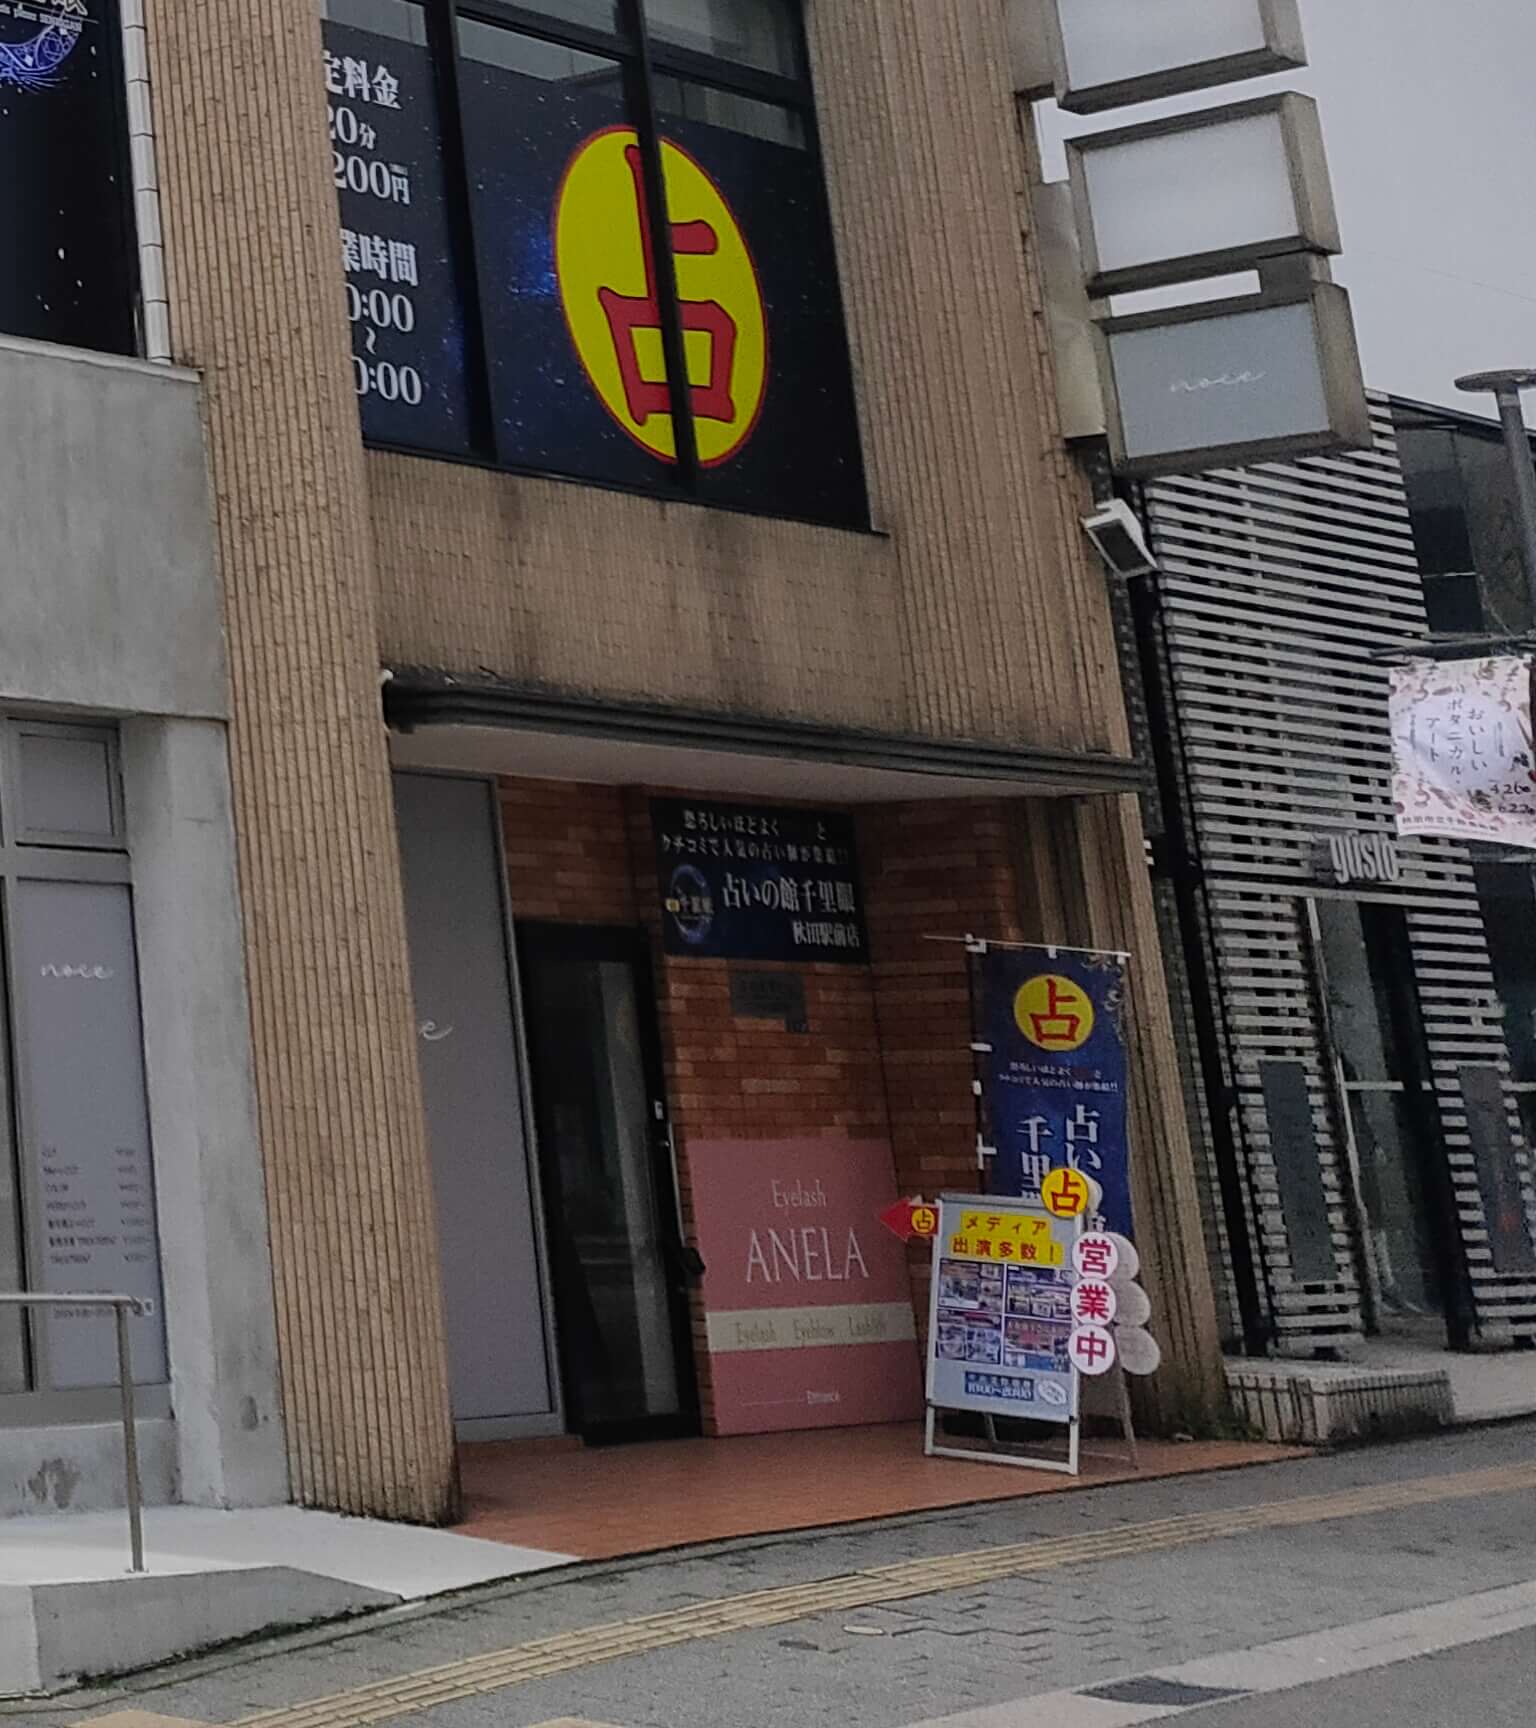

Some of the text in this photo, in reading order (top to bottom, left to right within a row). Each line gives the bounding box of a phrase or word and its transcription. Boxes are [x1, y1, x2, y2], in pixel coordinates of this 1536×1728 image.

[598, 144, 738, 426] 占
[1029, 978, 1081, 1042] 占
[771, 1178, 827, 1214] Eyelash
[1051, 1170, 1081, 1213] 占
[965, 1215, 1047, 1235] メディア
[746, 1227, 870, 1283] ANELA
[1076, 1238, 1112, 1366] 営業中
